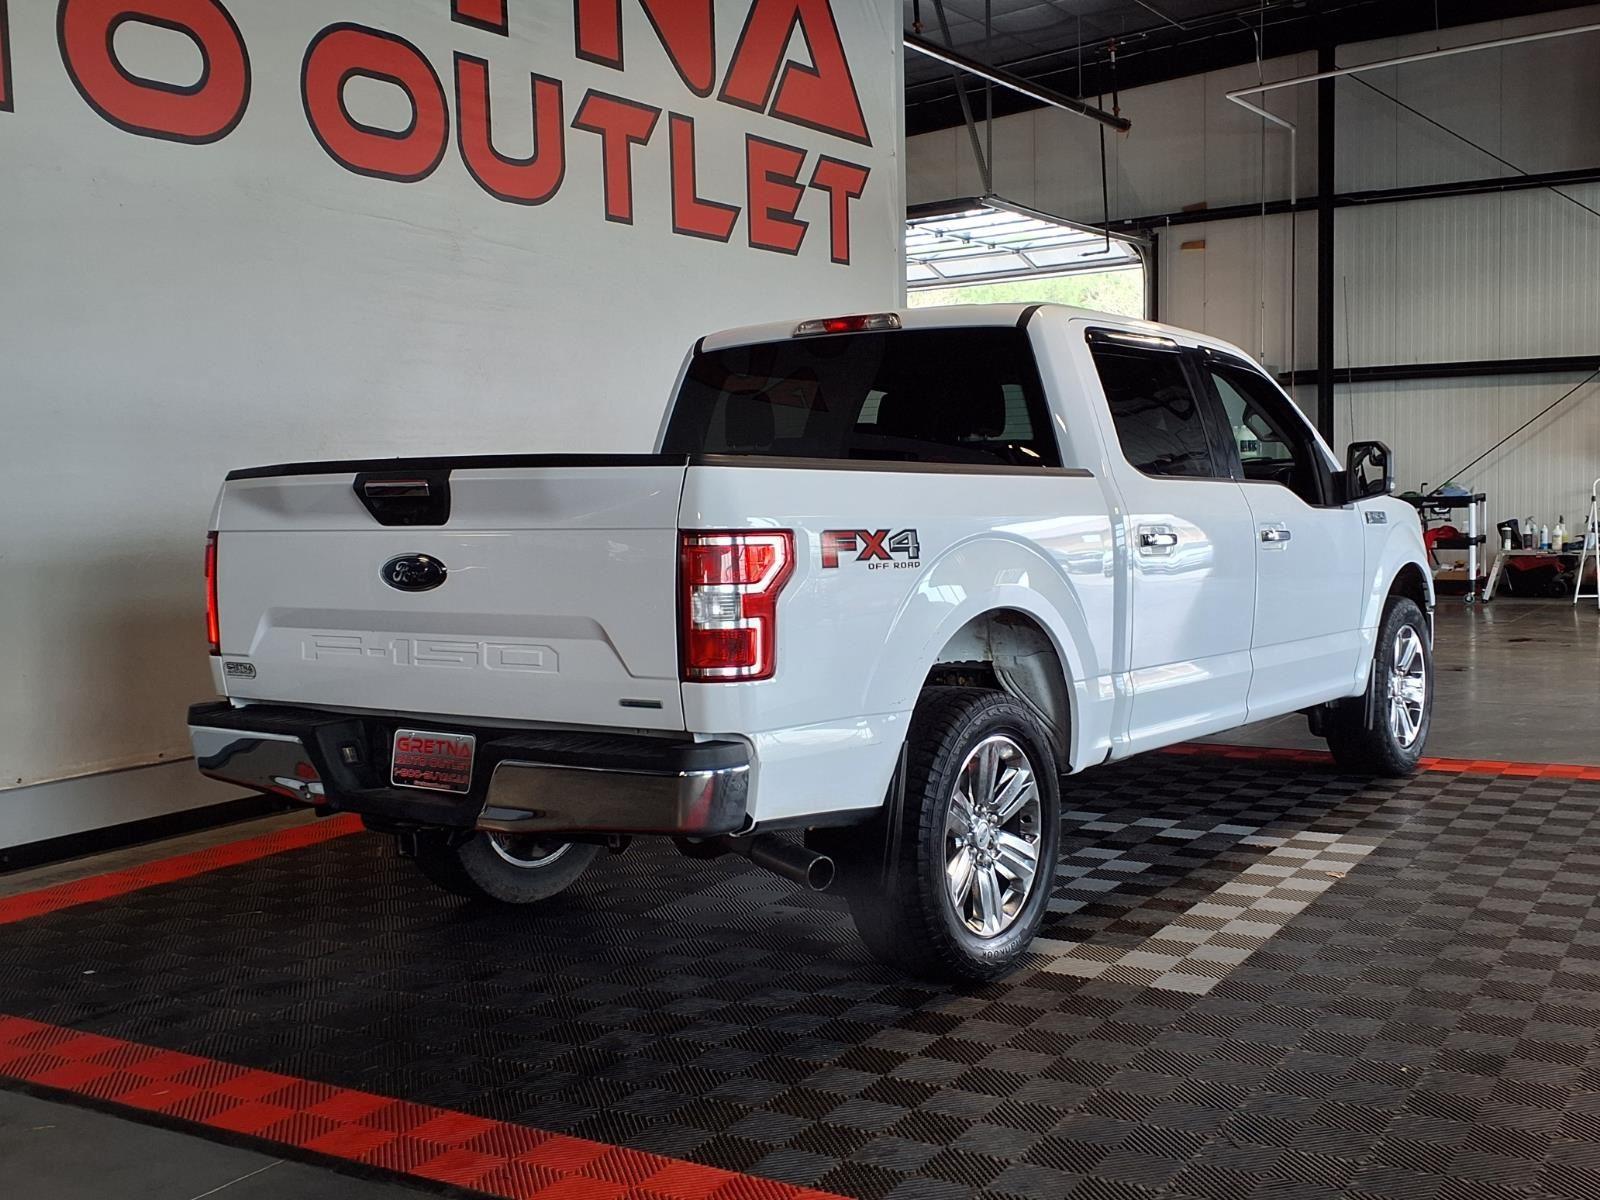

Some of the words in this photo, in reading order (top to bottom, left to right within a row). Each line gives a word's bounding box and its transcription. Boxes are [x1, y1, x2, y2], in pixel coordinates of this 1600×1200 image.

[301, 20, 872, 266] OUTLET
[820, 529, 920, 568] FX4
[392, 560, 431, 582] Ford
[868, 562, 889, 570] OFF
[893, 561, 920, 569] ROAD
[302, 634, 560, 674] F-150
[397, 736, 471, 757] GRETNA
